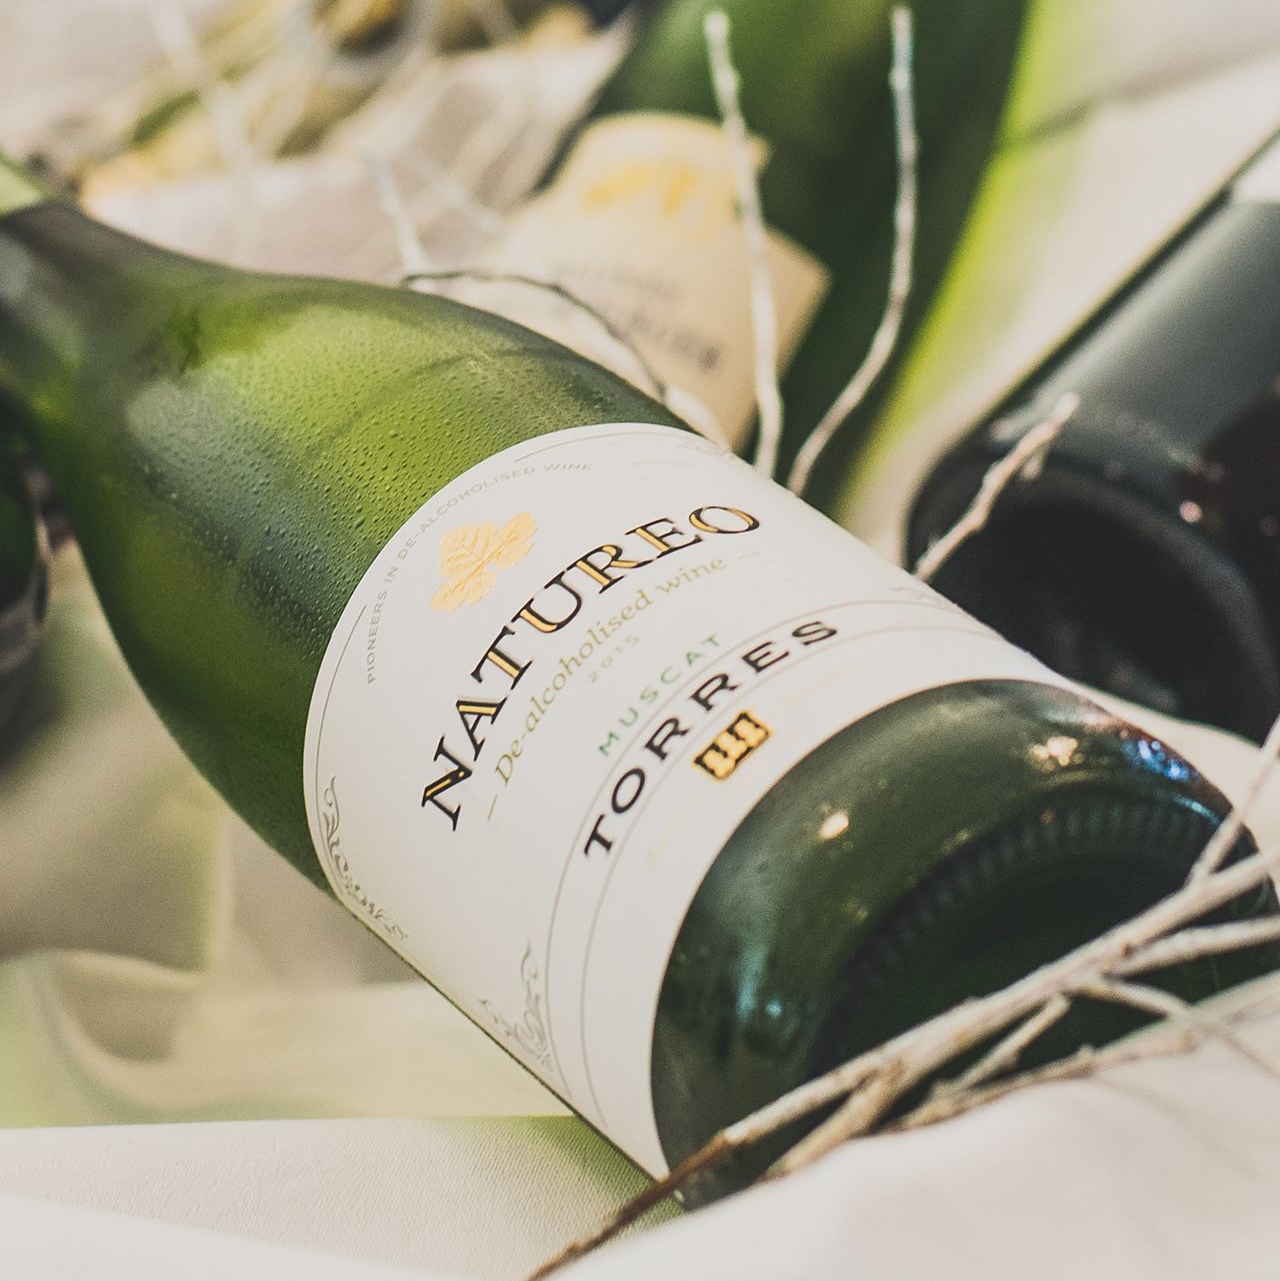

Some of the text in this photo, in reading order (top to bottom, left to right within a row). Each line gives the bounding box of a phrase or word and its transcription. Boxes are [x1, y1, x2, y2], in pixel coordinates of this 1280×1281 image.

[367, 462, 593, 685] PIONEERS IN DE-ALCOHOLISED WINE
[420, 505, 762, 831] NATUREO
[495, 558, 725, 785] De-alcoholised wine
[583, 621, 838, 860] TORRES
[598, 633, 722, 756] MUSCAT
